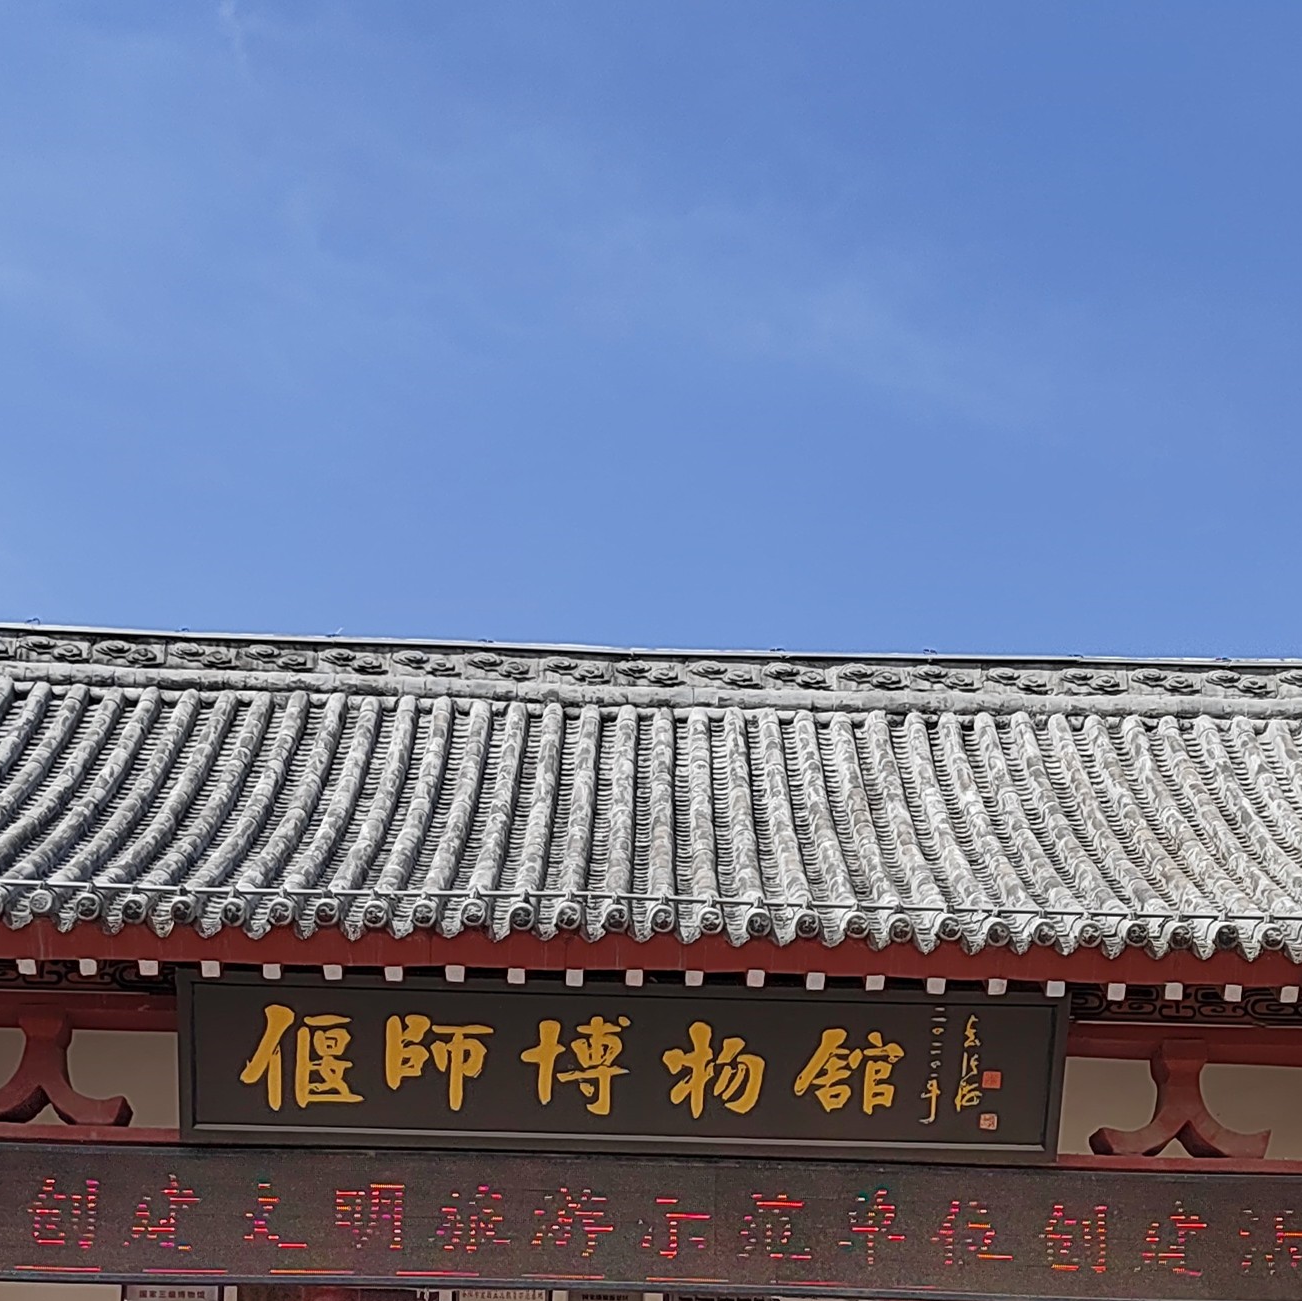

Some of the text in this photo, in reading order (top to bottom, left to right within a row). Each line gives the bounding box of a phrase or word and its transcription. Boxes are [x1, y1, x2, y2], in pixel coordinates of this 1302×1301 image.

[239, 1003, 903, 1119] 偃師博物館
